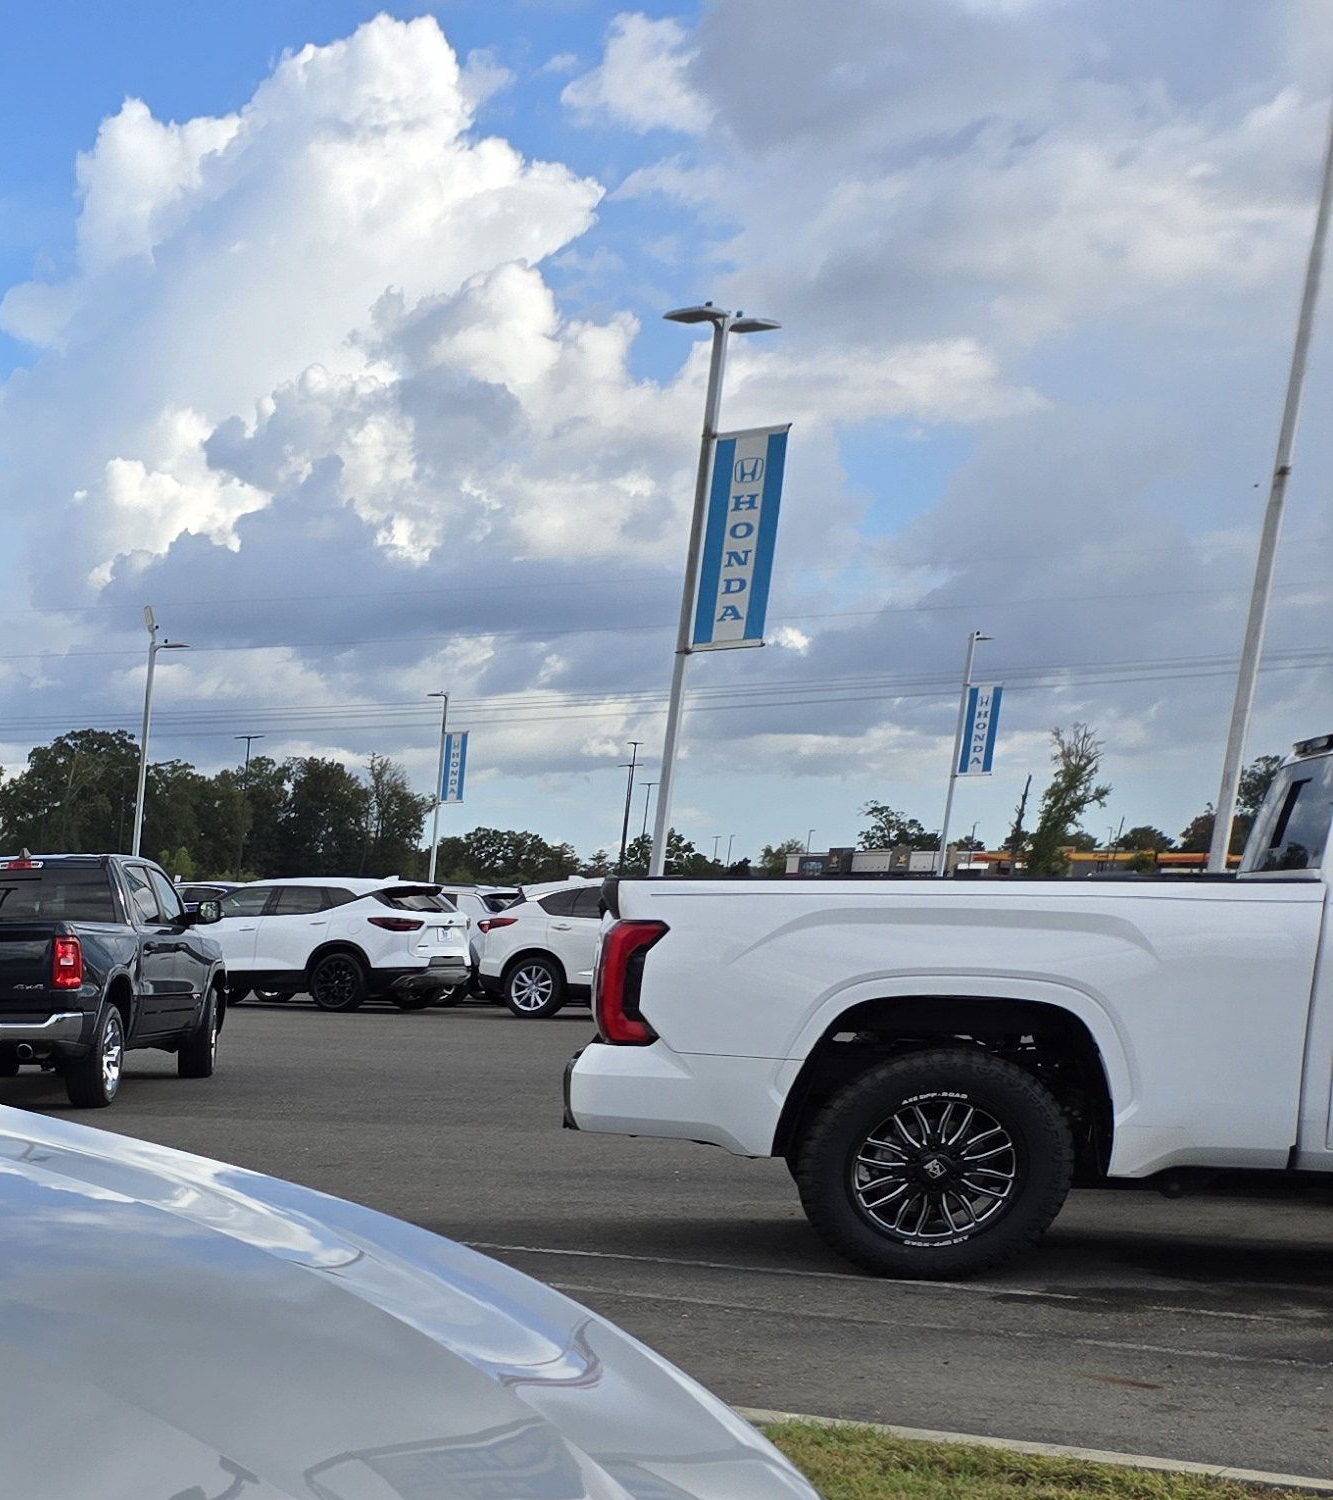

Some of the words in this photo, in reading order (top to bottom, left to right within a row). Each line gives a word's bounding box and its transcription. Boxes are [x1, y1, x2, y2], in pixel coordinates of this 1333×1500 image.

[716, 493, 759, 622] HONDA
[969, 710, 990, 765] HONDA
[448, 752, 460, 795] HONDA
